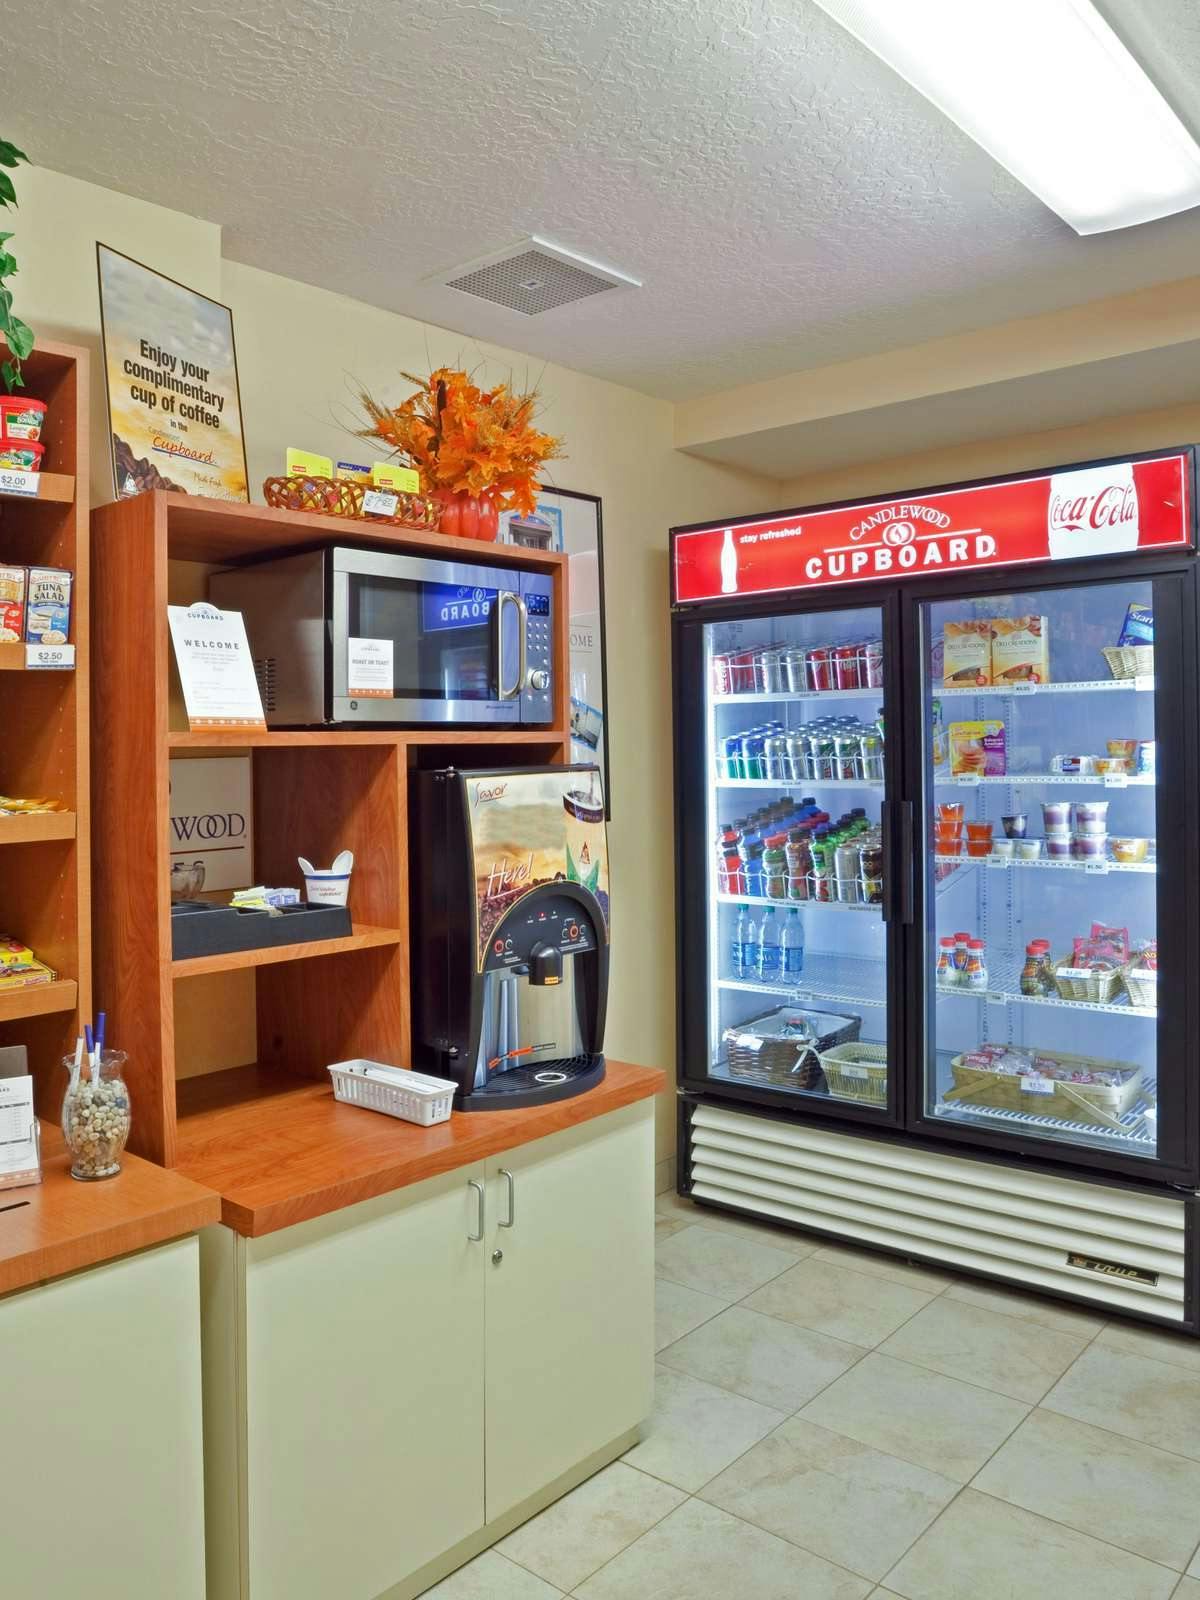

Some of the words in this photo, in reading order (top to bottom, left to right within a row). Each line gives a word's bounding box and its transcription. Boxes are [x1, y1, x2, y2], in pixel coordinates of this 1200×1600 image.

[140, 339, 177, 373] Enjoy
[181, 360, 210, 383] your
[123, 360, 225, 413] complimentary
[130, 385, 158, 410] cup
[161, 396, 176, 414] of
[179, 403, 220, 429] coffee
[1, 475, 26, 486] $2.00
[849, 504, 951, 541] CANDLEWOOD
[740, 534, 758, 545] stay
[759, 526, 802, 542] refreshed
[805, 535, 996, 579] CUPBOARD
[33, 591, 65, 602] SALAD
[36, 582, 62, 593] TUNA
[187, 612, 224, 621] CUPBOARD
[184, 639, 241, 650] WELCOME
[37, 652, 63, 661] $2.50
[473, 782, 508, 808] Savor
[486, 852, 534, 898] Here!
